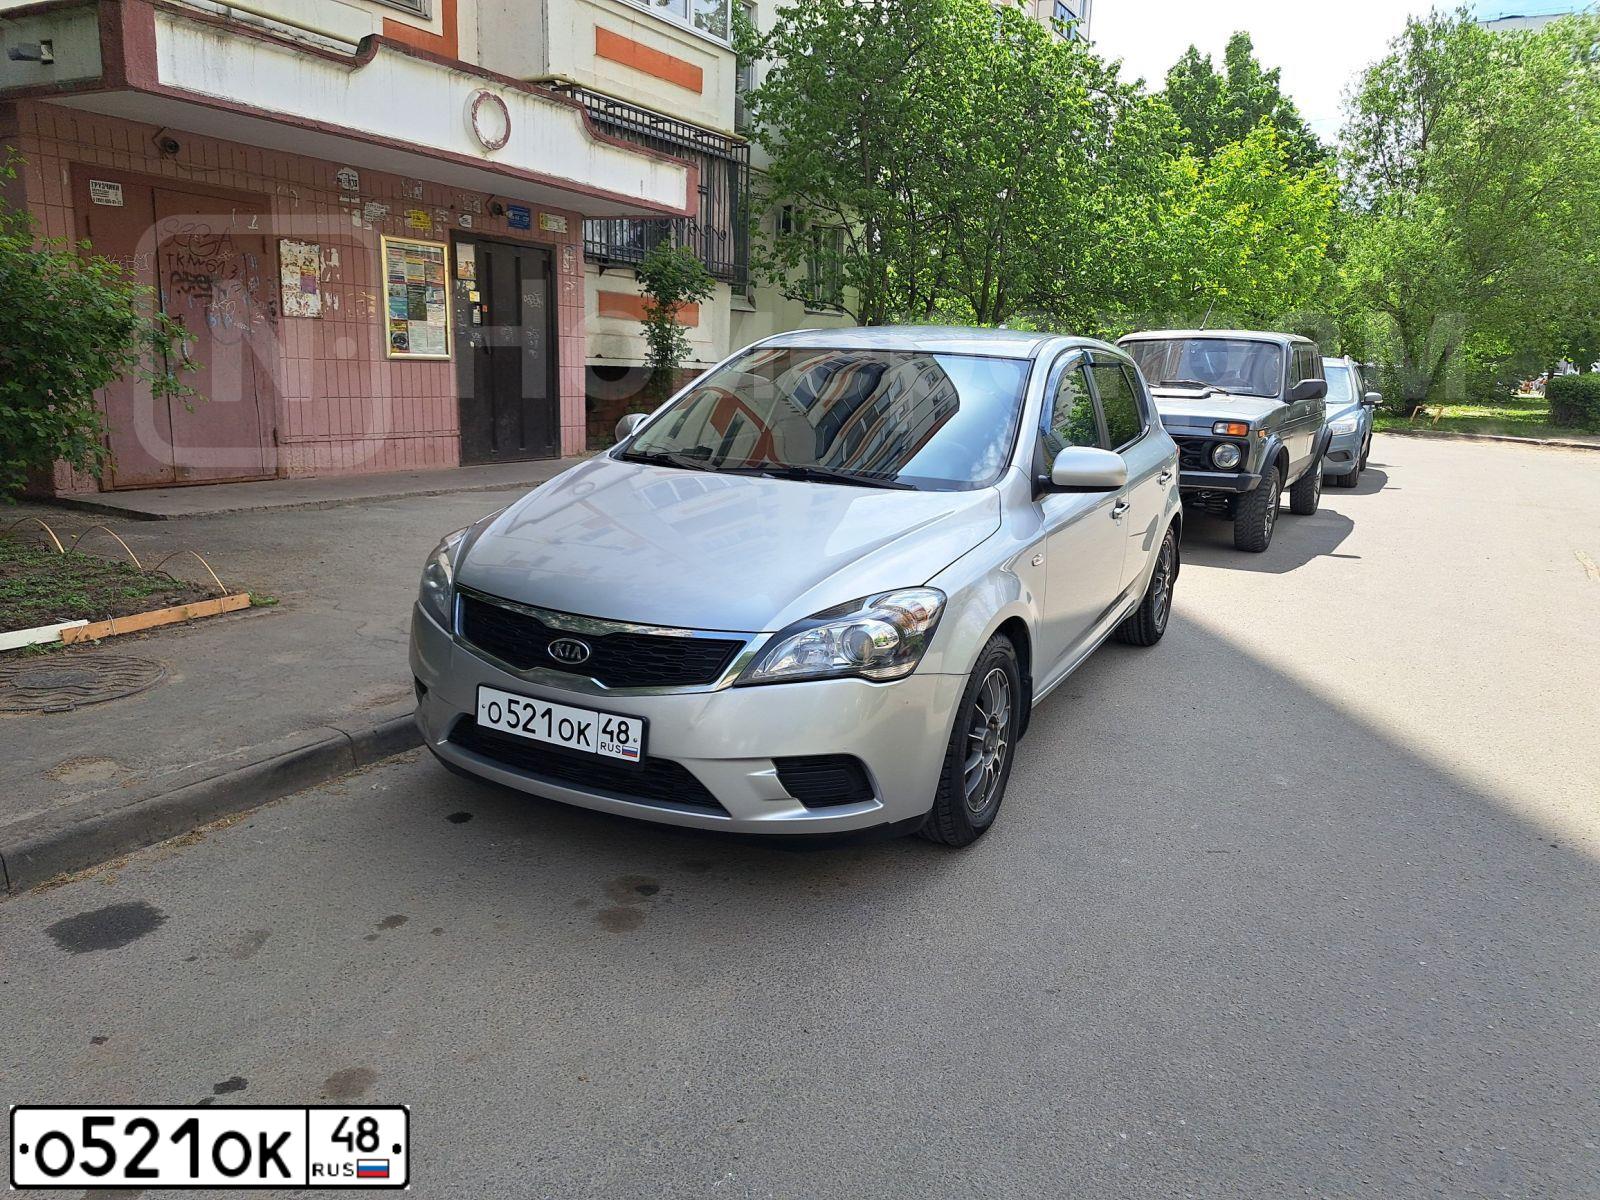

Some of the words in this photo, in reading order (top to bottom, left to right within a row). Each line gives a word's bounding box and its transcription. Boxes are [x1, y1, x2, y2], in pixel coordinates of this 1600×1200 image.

[553, 642, 582, 661] KIA
[602, 718, 630, 744] 48
[600, 741, 622, 754] RUS
